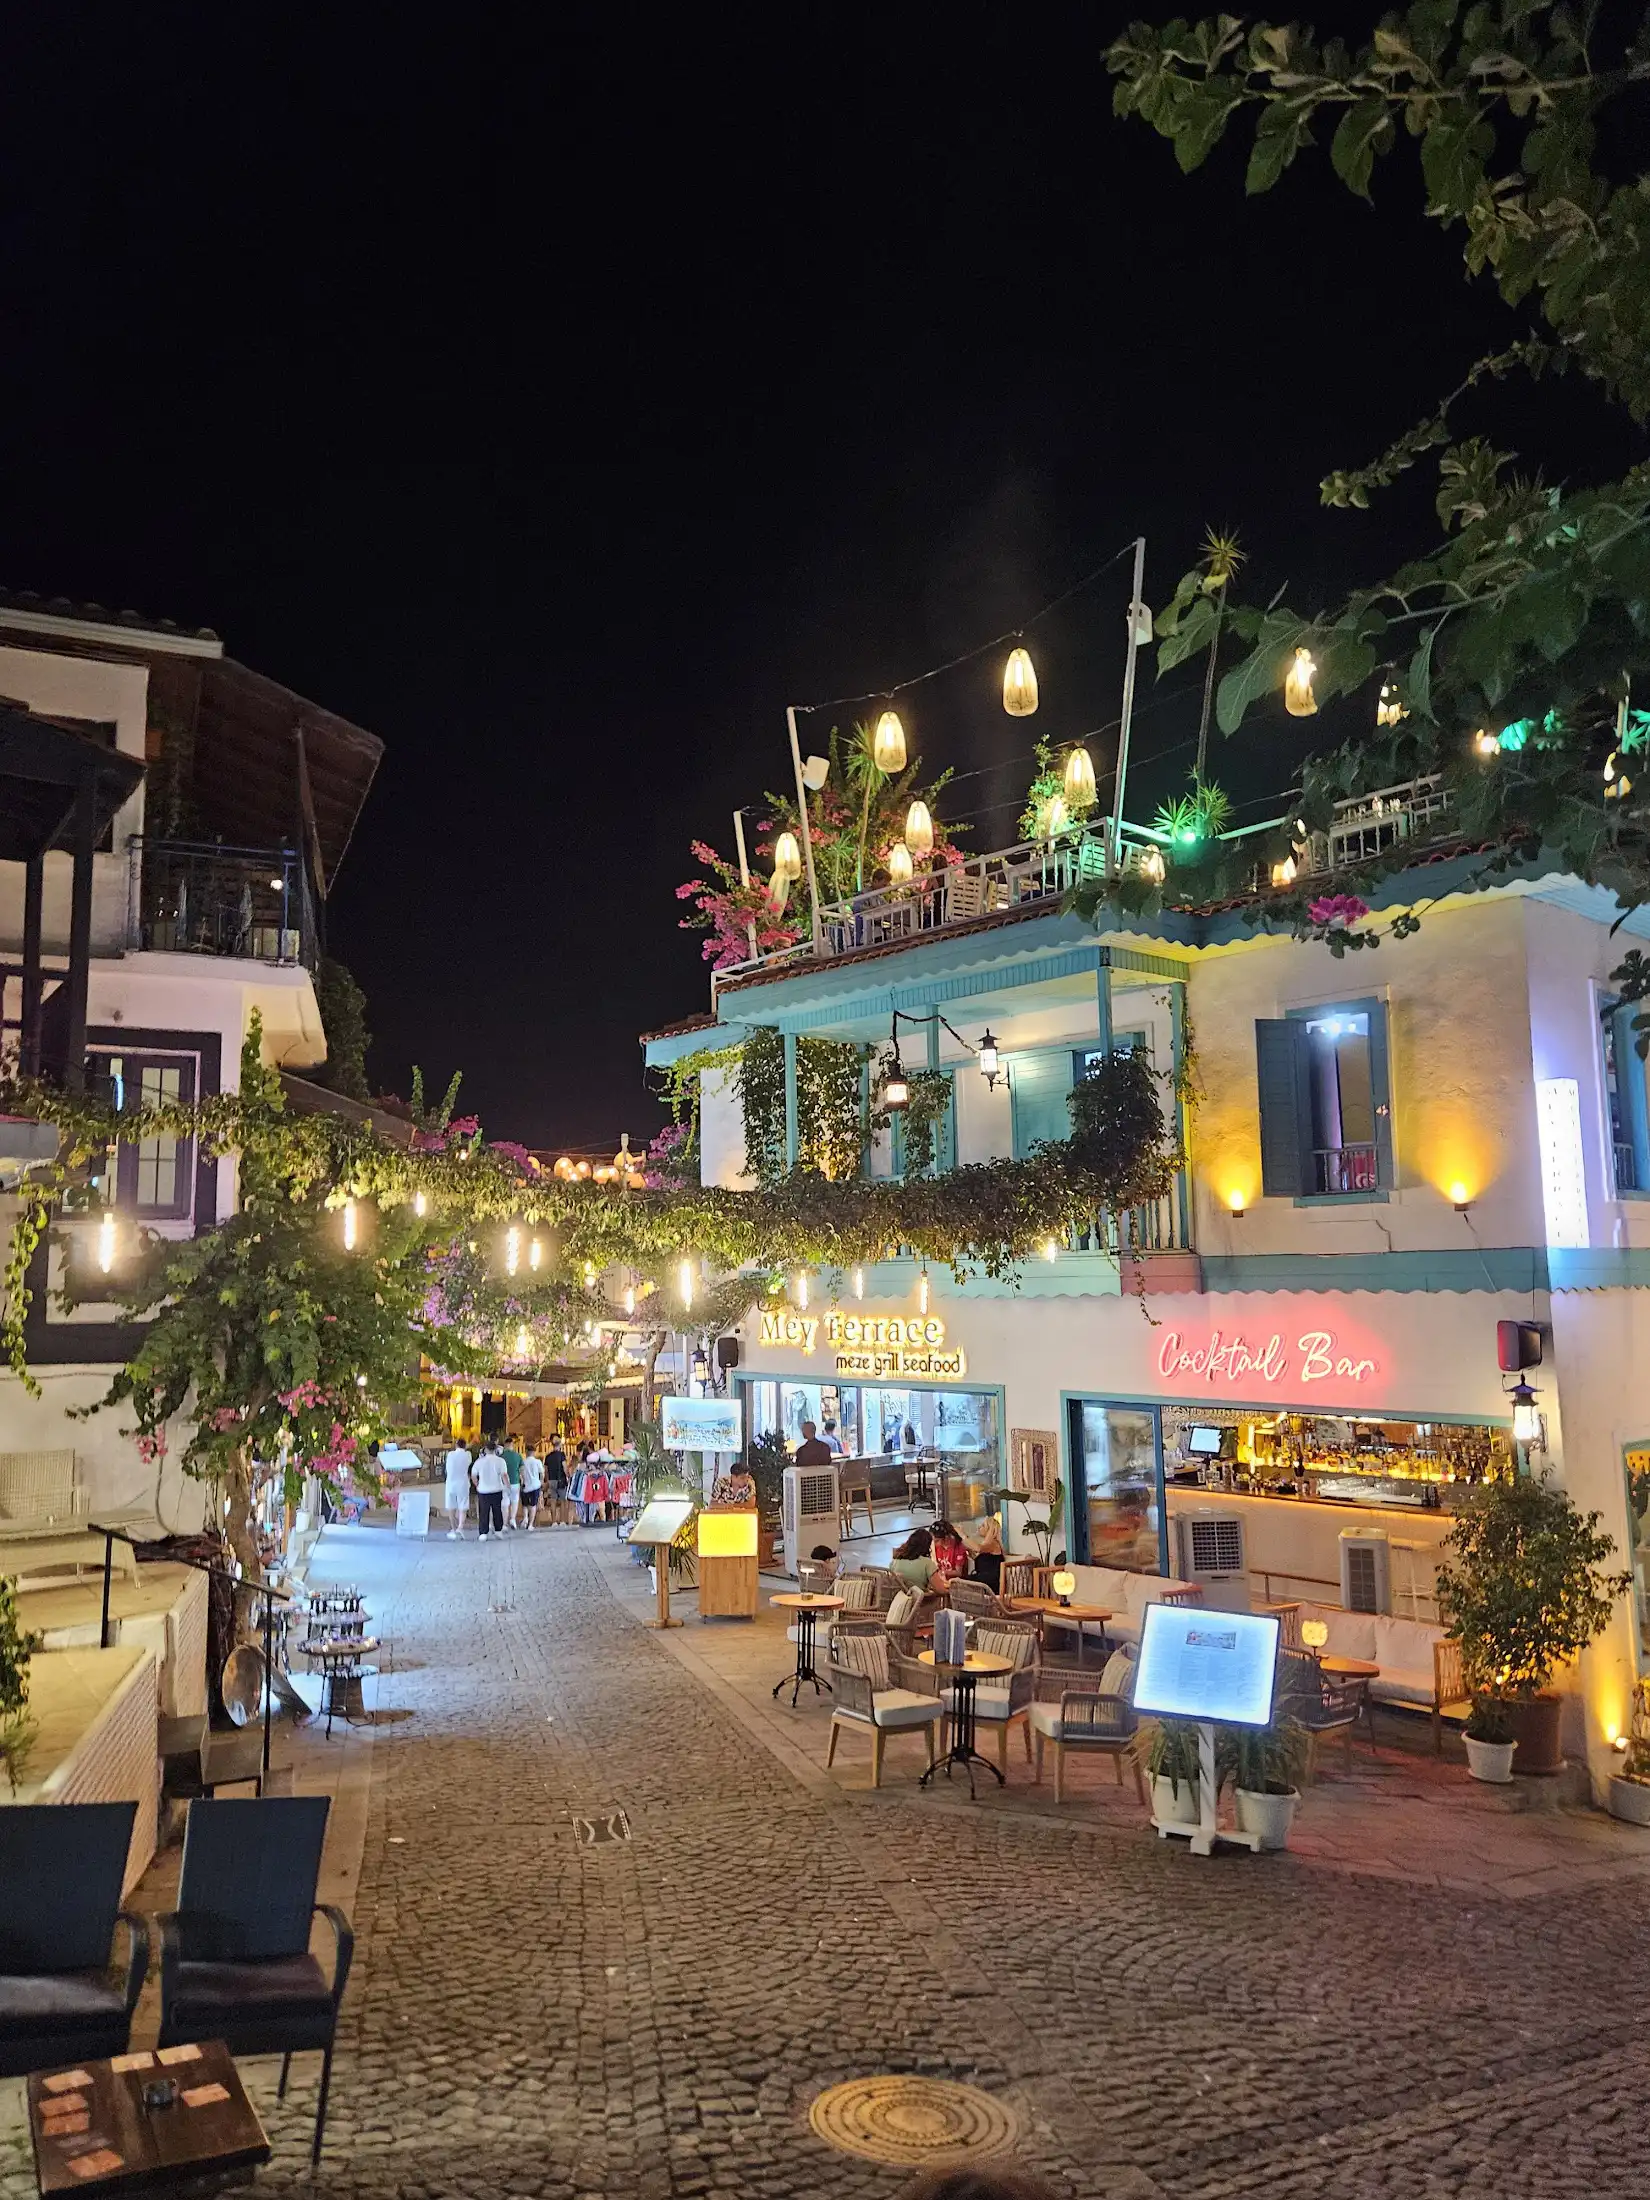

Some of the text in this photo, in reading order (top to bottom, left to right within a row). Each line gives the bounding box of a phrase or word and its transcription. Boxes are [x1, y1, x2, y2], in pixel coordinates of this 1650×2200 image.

[759, 1314, 943, 1349] Mey Terrace
[835, 1352, 961, 1376] meze grill seafood
[1158, 1330, 1376, 1383] Cocktail Bar
